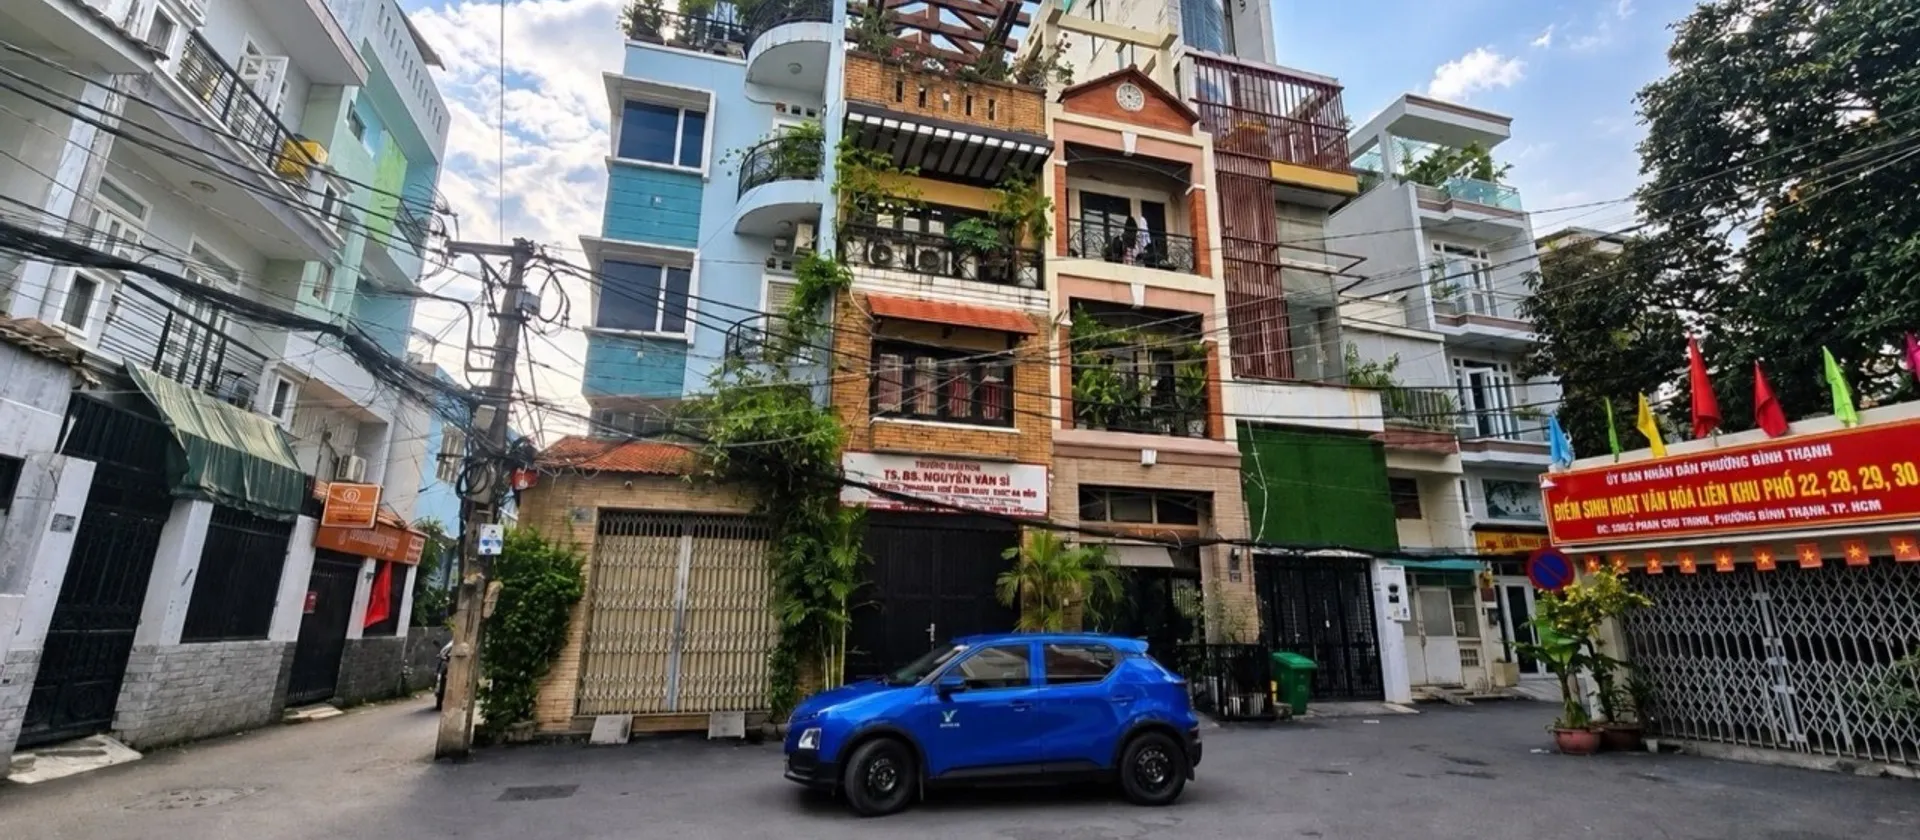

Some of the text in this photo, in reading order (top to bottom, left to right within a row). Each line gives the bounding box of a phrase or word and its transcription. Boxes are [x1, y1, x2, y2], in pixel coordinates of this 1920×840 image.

[1621, 470, 1642, 483] BAN
[1644, 464, 1673, 480] NHÂN
[1675, 461, 1699, 476] DÂN
[1700, 455, 1749, 473] PHƯỜNG
[1751, 449, 1783, 466] BÌNH
[1785, 443, 1833, 462] THẠNH
[1582, 498, 1609, 519] SINH
[1610, 494, 1640, 518] HOẠT
[1641, 488, 1668, 512] VĂN
[1697, 480, 1729, 507] LIÊN
[1729, 480, 1760, 504] KHU
[1762, 469, 1796, 500] PHỐ
[1798, 472, 1827, 498] 22,
[1827, 469, 1858, 495] 28,
[1858, 465, 1891, 492] 29,
[1635, 519, 1660, 530] PHAN
[1661, 517, 1680, 528] CHU
[1714, 509, 1756, 524] PHƯỜNG
[1758, 507, 1785, 520] BÌNH
[1831, 502, 1849, 514] TP.
[1851, 499, 1882, 512] HCM
